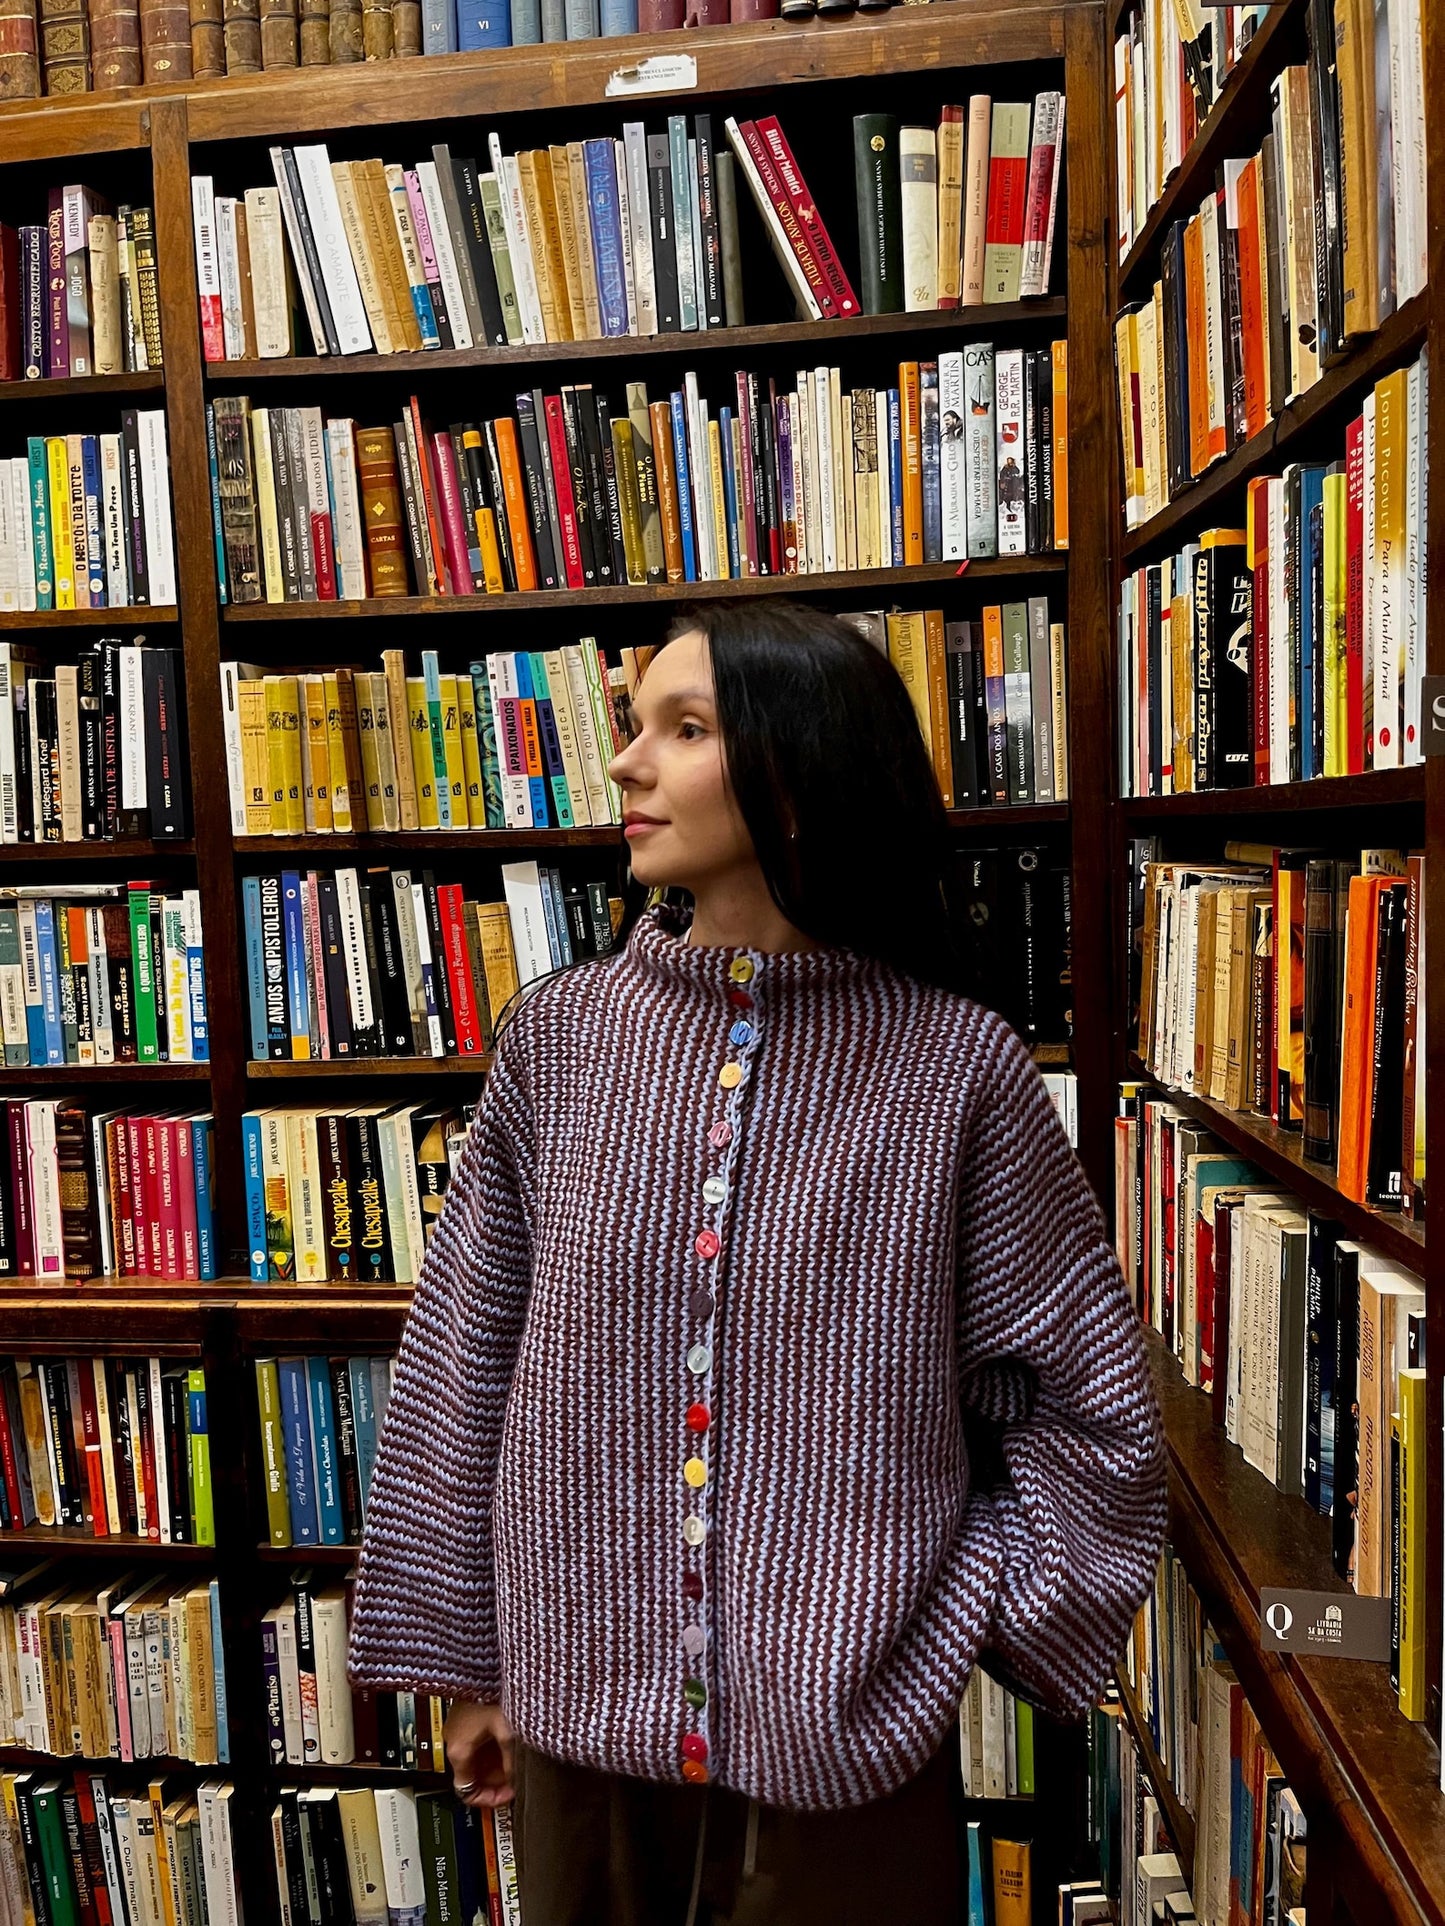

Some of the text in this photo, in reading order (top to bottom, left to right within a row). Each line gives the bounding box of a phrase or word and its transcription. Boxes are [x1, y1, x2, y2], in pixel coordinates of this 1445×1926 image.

[701, 145, 710, 176] MEDIDA
[764, 129, 803, 196] Hilary Mantel
[703, 176, 711, 188] DO
[69, 202, 81, 238] KENNEDY
[704, 189, 712, 218] HOMEM
[776, 200, 824, 287] A ILHA DE AVALON
[808, 222, 846, 296] O LIVRO NEGRO
[71, 274, 84, 298] JOGO
[707, 235, 716, 300] MARCO MALVALDI
[30, 231, 42, 358] CRISTO RECRUCIFICADO
[949, 360, 960, 408] MARTIN
[998, 371, 1009, 411] GEORGE
[31, 444, 42, 468] KIRST
[105, 447, 116, 470] KIRST
[308, 419, 320, 460] JUDEUS
[1041, 406, 1052, 501] ALLAN MASSIE TIBÉRIO
[1057, 437, 1066, 455] TIM
[315, 479, 323, 497] FIM
[636, 460, 648, 503] de Pianos
[644, 455, 656, 505] O Afinador
[794, 460, 802, 491] OLHOS
[946, 444, 960, 521] MURALHA GELO
[1028, 438, 1038, 505] ALLAN MASSIE
[1348, 448, 1358, 504] PESSL
[1408, 430, 1418, 522] PICOULT
[607, 477, 619, 510] MASSIE
[795, 492, 802, 505] DE
[86, 494, 99, 533] SINISTRO
[610, 511, 621, 542] ALLAN
[796, 506, 804, 526] CÃO
[89, 534, 100, 561] AMIGO
[318, 521, 329, 574] ADAM MANSBACH
[370, 534, 396, 544] CARTAS
[1380, 390, 1394, 700] JODI PICOULT Para a Minha Irmã
[1406, 532, 1419, 571] Tudo
[1406, 578, 1416, 610] por
[1013, 632, 1024, 673] McCullough
[1406, 613, 1419, 667] Amor
[1196, 558, 1212, 766] roger peyrefitte
[104, 673, 114, 697] Judith
[576, 694, 585, 707] EU
[504, 700, 521, 772] APAIXONADOS
[558, 706, 574, 758] REBECA
[579, 712, 592, 748] OUTRO
[993, 707, 1002, 734] ANJOS
[104, 712, 117, 783] DE MISTRAL
[994, 734, 1002, 751] DOS
[994, 752, 1003, 772] CASA
[38, 738, 53, 822] Hildegard Knef
[2, 774, 14, 827] IMORTALIDADE
[431, 904, 440, 932] RICHELLE
[552, 874, 566, 934] EDUARDO MENDOZA
[59, 906, 71, 971] Jean Lartéguy
[136, 924, 149, 960] CAVALEIRO
[165, 910, 173, 949] DOMINIQUE
[594, 920, 603, 951] ROBERT
[154, 954, 161, 966] DO
[262, 878, 286, 1024] ANJOS PISTOLEIROS
[94, 955, 105, 1028] Os Mercenários
[138, 960, 150, 987] QUINTO
[155, 967, 164, 1005] MINISTROS
[114, 966, 130, 1036] OS CENTURIÕES
[158, 1005, 164, 1016] OS
[404, 1153, 417, 1221] OS INADAPTADOS
[426, 1164, 438, 1196] SEXUS
[1134, 1176, 1142, 1204] Azuis
[251, 1195, 262, 1239] ESPAÇO
[328, 1178, 352, 1249] Chesapeake
[358, 1178, 384, 1249] Chesapeake
[1134, 1205, 1142, 1239] Moscas
[152, 1368, 161, 1409] MARC LEVY
[335, 1370, 354, 1456] Sveva Casati Modignani
[269, 1470, 280, 1492] Giulia
[298, 1592, 310, 1642] DESOBEDIÊNCIA
[1266, 1602, 1294, 1640] Q
[1316, 1619, 1342, 1629] LIVRARIA
[1316, 1627, 1325, 1636] DA
[1326, 1628, 1342, 1638] COSTA
[194, 1629, 207, 1712] DEBAIXO DO VULCÃO
[214, 1668, 225, 1722] AFRODITE
[137, 1818, 155, 1835] H
[351, 1824, 360, 1850] SANGUE
[498, 1819, 511, 1844] DOU-TE
[354, 1851, 362, 1865] DOS
[501, 1852, 513, 1866] SOL
[122, 1847, 134, 1877] Dupla
[128, 1880, 139, 1922] Imagem
[355, 1866, 366, 1902] INOCENTES
[434, 1856, 451, 1922] Não Matarás
